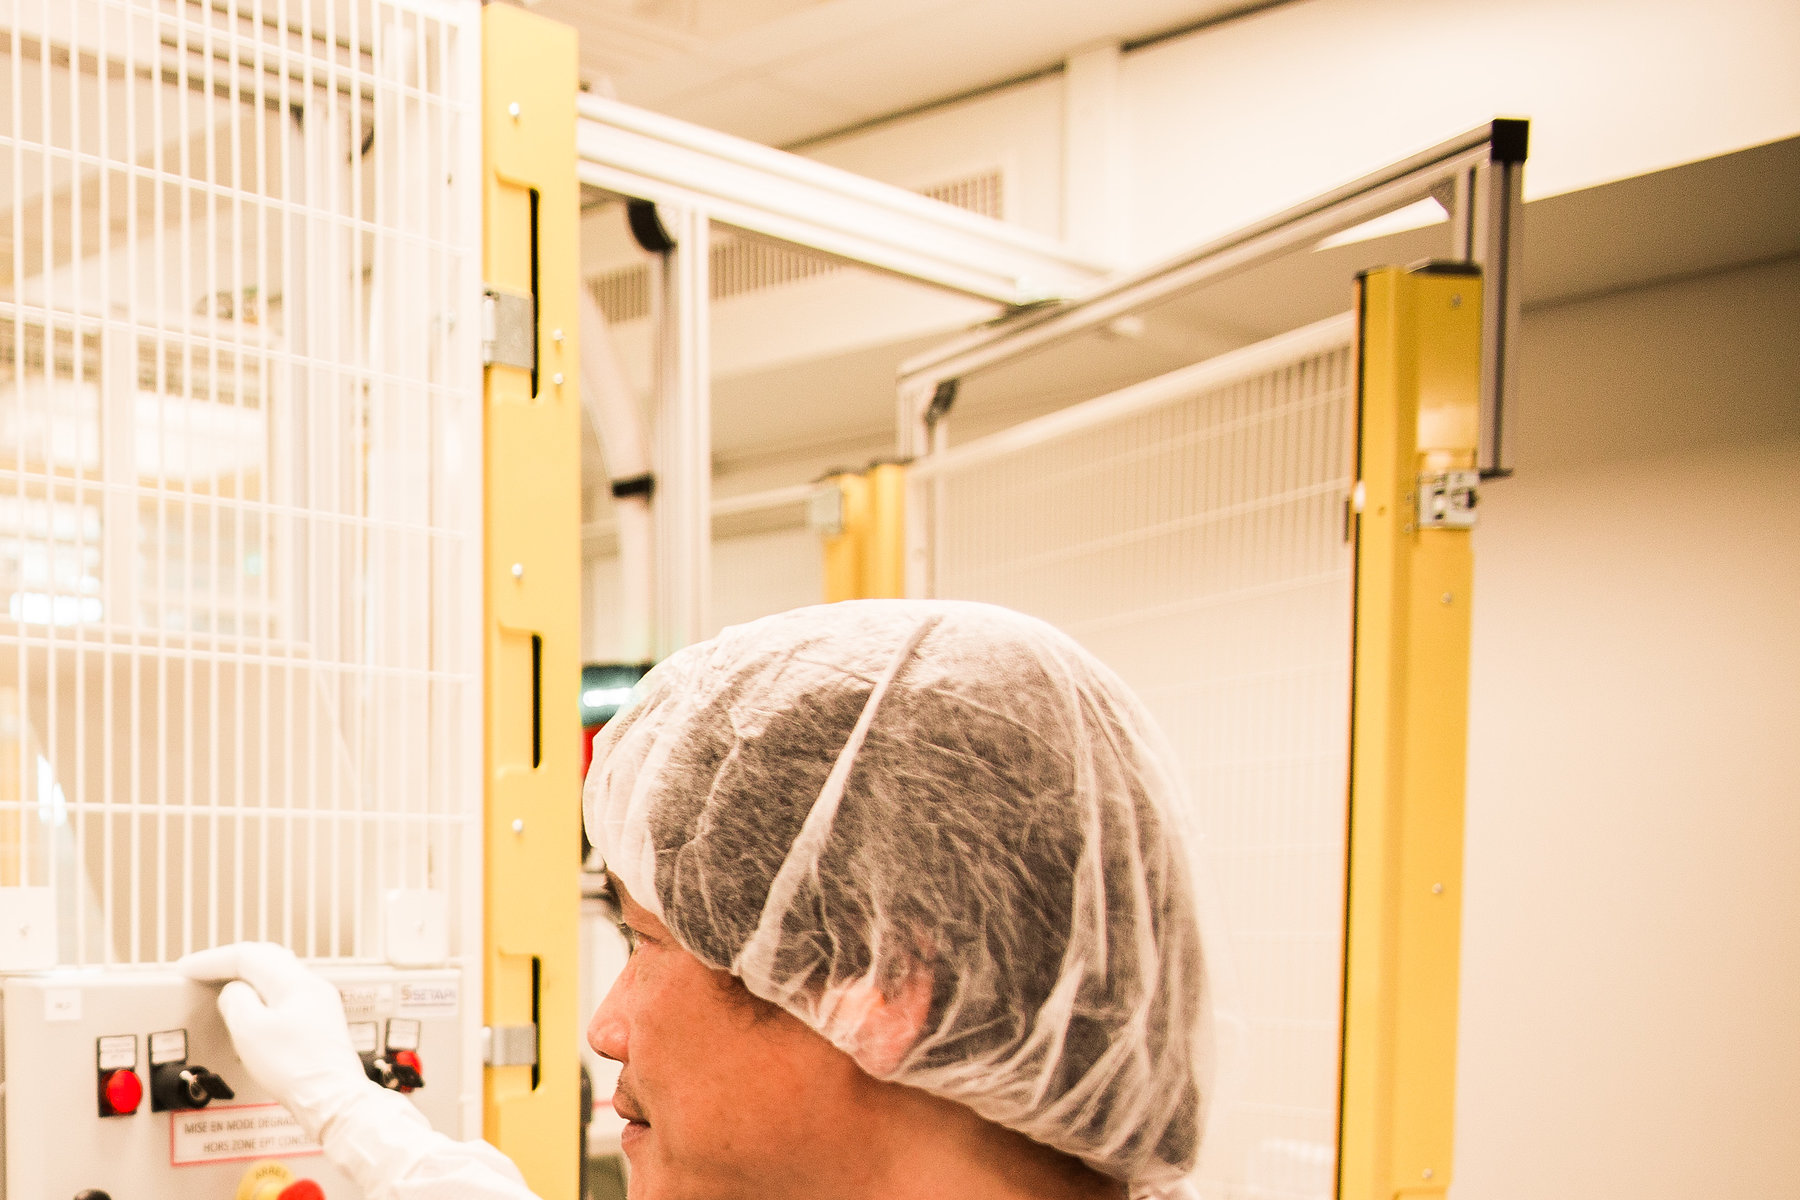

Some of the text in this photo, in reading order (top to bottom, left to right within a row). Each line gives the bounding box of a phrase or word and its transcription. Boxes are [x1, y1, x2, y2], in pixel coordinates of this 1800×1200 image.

[184, 1118, 208, 1135] MISE
[211, 1118, 223, 1133] EN
[226, 1116, 255, 1133] MODE
[203, 1138, 229, 1153] HORS
[232, 1136, 257, 1151] ZONE
